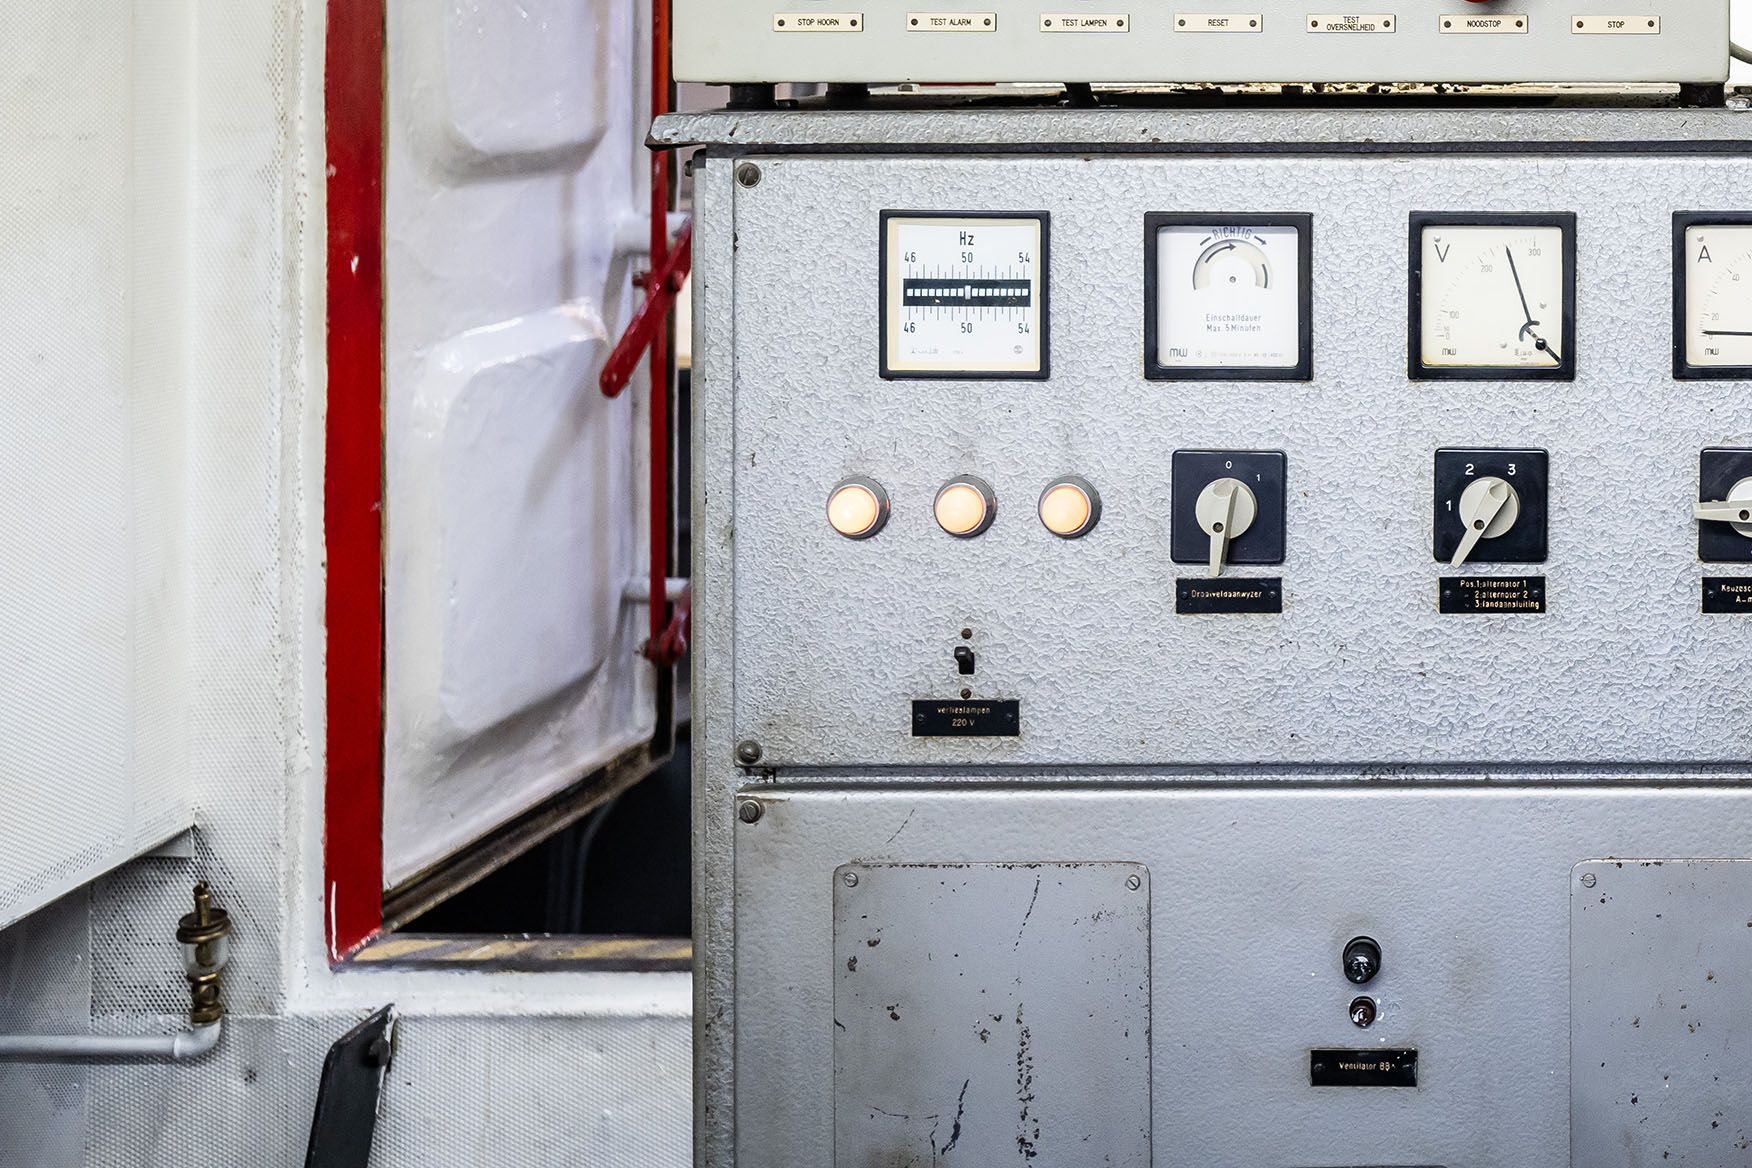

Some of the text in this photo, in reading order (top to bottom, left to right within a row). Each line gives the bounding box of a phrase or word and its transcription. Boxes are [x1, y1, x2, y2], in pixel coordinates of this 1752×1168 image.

[798, 18, 839, 26] STOP HOORN
[930, 18, 971, 26] TEST ALARM
[1062, 19, 1107, 27] TEST LAMPEN
[1208, 18, 1229, 27] RESET
[1343, 16, 1359, 24] TEST
[1467, 20, 1501, 28] NOODSTOP
[1608, 20, 1625, 28] STOP
[1326, 23, 1375, 31] OVERSNELHEID
[1212, 227, 1252, 239] RICHTIG
[960, 231, 974, 246] Hz
[904, 252, 916, 262] 46
[962, 252, 973, 262] 50
[1019, 252, 1030, 263] 54
[1435, 244, 1450, 262] V
[1698, 245, 1712, 262] A
[904, 322, 915, 333] 46
[961, 323, 972, 333] 50
[1018, 323, 1030, 334] 54
[1226, 461, 1233, 469] 0
[1465, 464, 1474, 476] 2
[1507, 464, 1516, 476] 3
[1256, 474, 1261, 482] 1
[1446, 500, 1452, 511] 1
[1339, 1062, 1376, 1070] Ventilator
